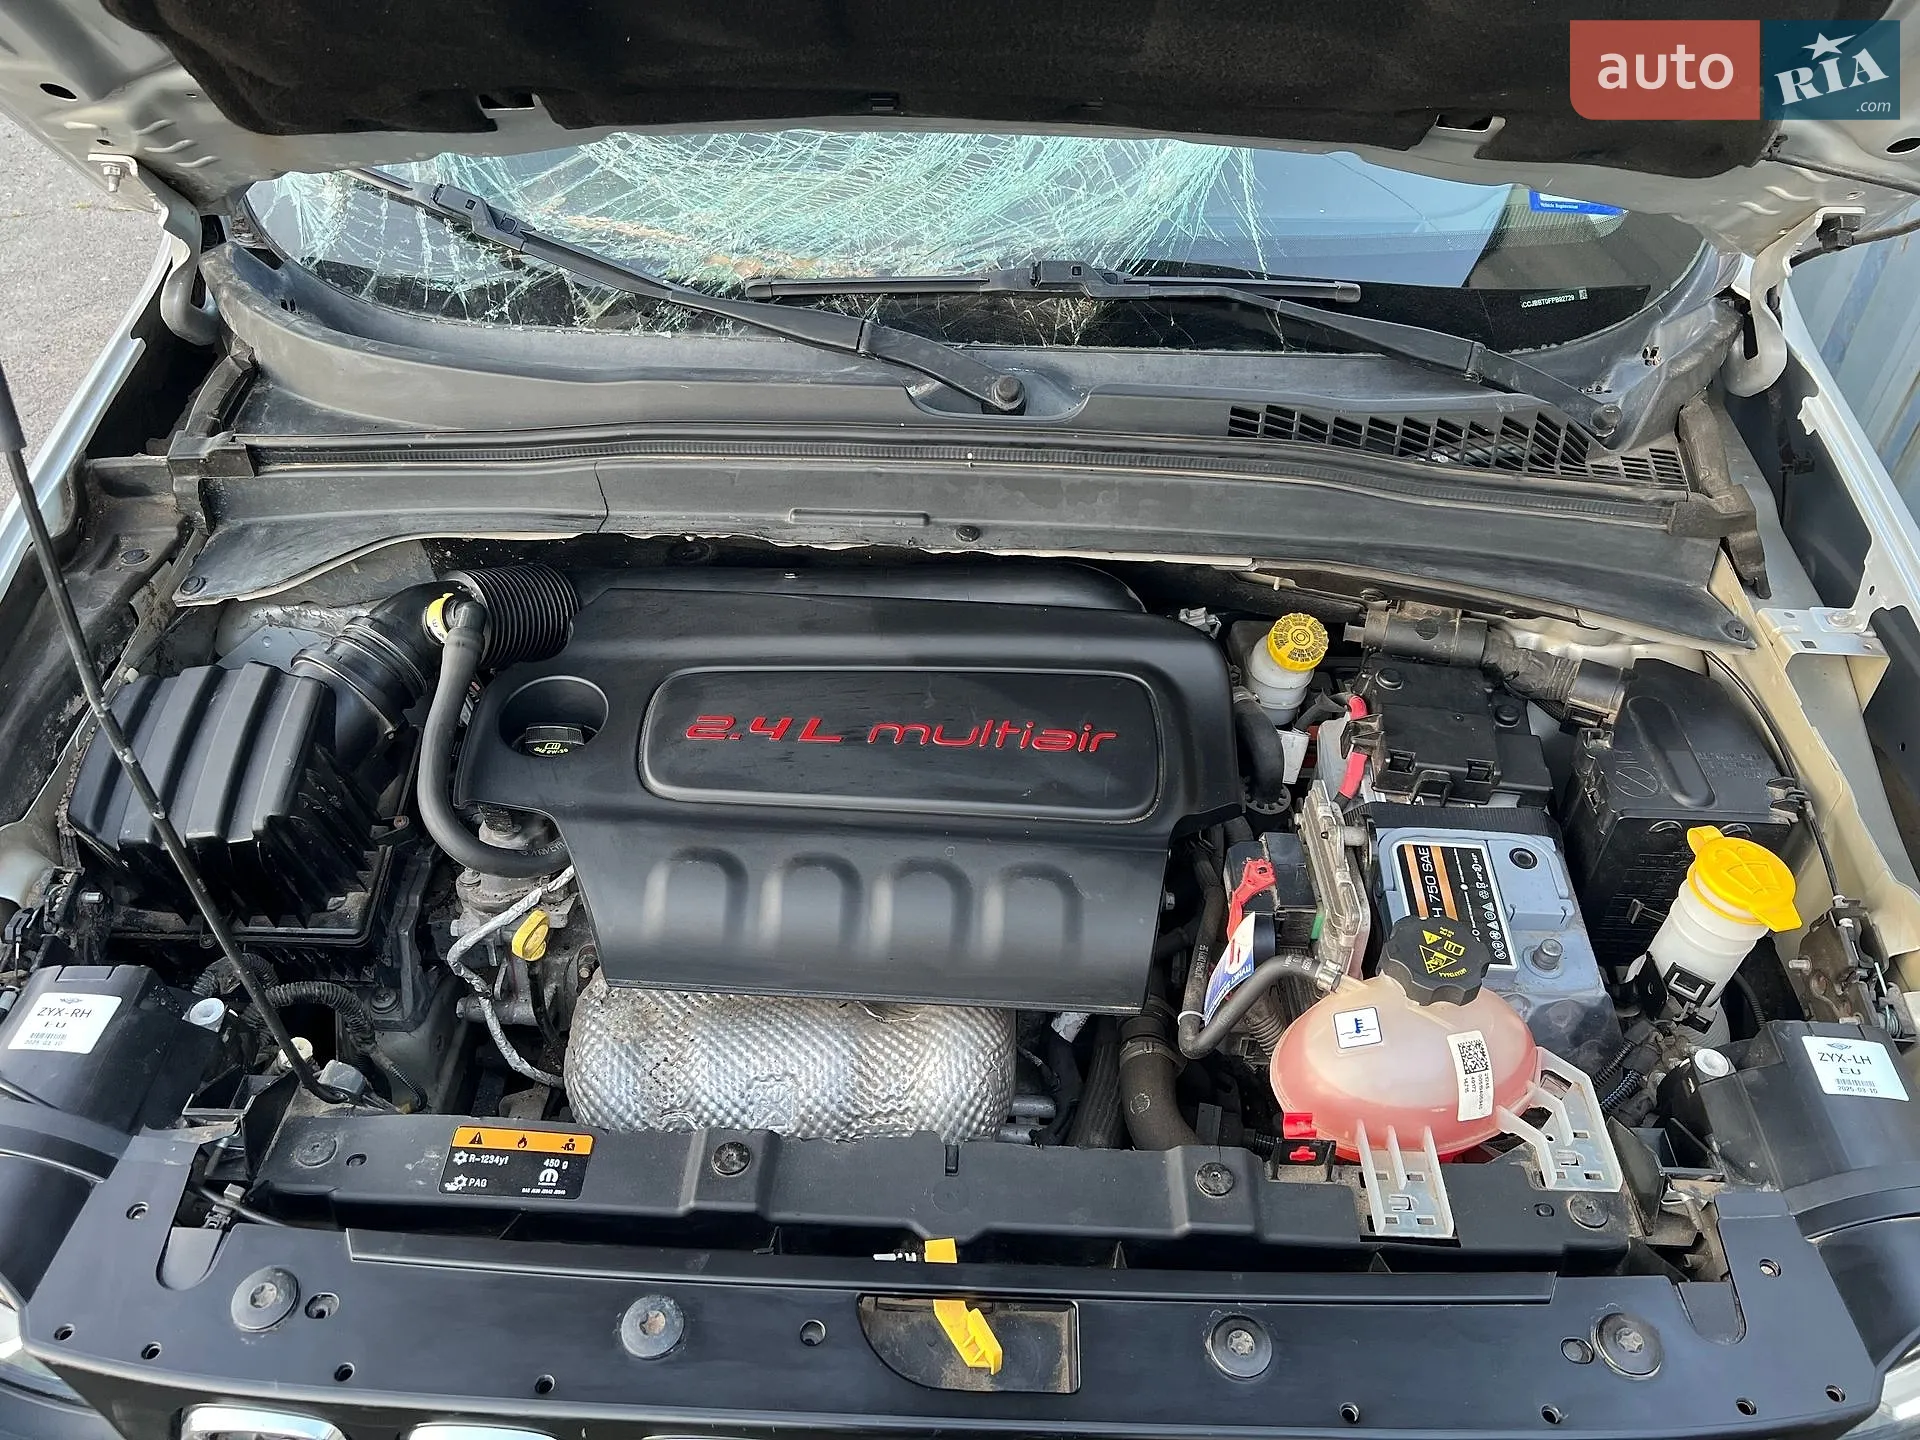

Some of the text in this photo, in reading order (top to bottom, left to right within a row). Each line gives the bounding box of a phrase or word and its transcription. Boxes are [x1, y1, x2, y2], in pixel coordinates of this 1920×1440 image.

[867, 718, 1117, 754] multiair
[1418, 847, 1434, 873] SAE
[1425, 872, 1441, 904] 750
[37, 1007, 93, 1019] ZYX-RH
[1817, 1052, 1872, 1066] ZYX-LH
[1839, 1067, 1861, 1076] EU
[468, 1153, 569, 1170] R-1234yf 450 g
[468, 1178, 488, 1188] PAG
